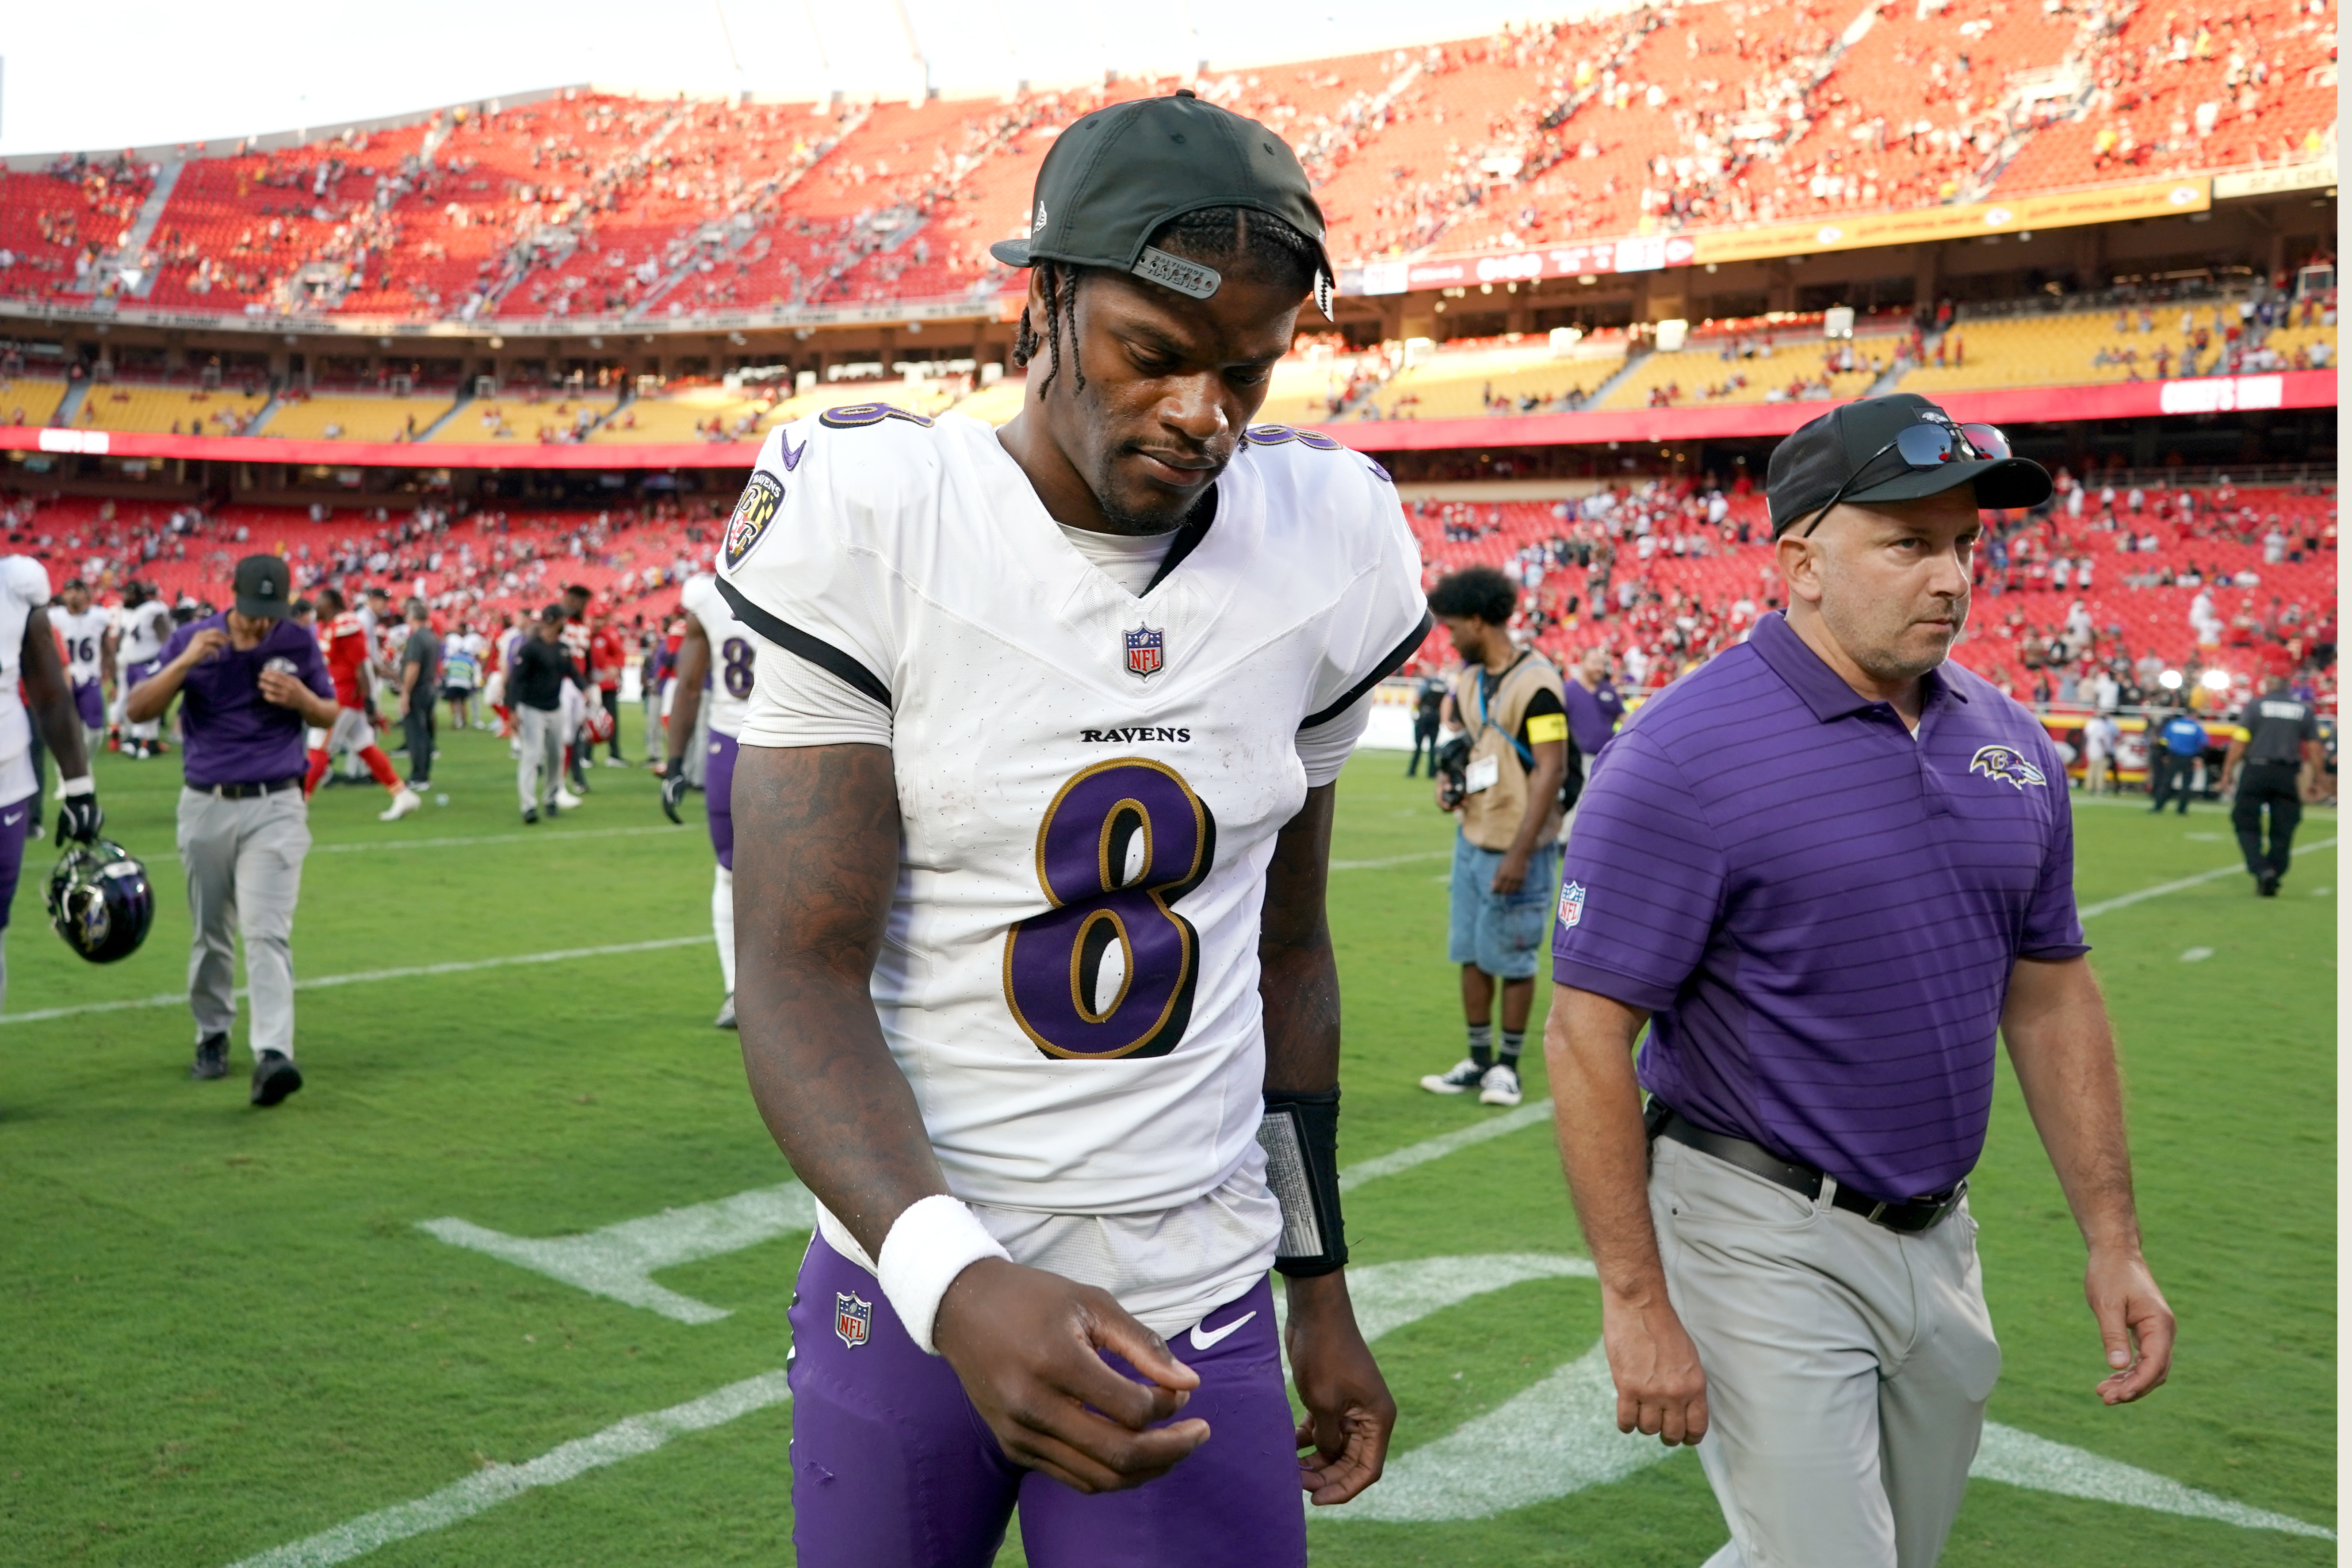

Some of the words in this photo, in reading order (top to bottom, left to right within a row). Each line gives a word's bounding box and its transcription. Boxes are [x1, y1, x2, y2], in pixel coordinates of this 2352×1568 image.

[1155, 255, 1205, 277] BALTIMORE
[1148, 268, 1199, 291] RAVENS
[753, 474, 782, 498] RAVENS
[1130, 649, 1160, 671] NFL
[1080, 727, 1191, 743] RAVENS
[1002, 756, 1217, 1060] 8
[1560, 900, 1577, 922] NFL
[840, 1314, 863, 1339] NFL
